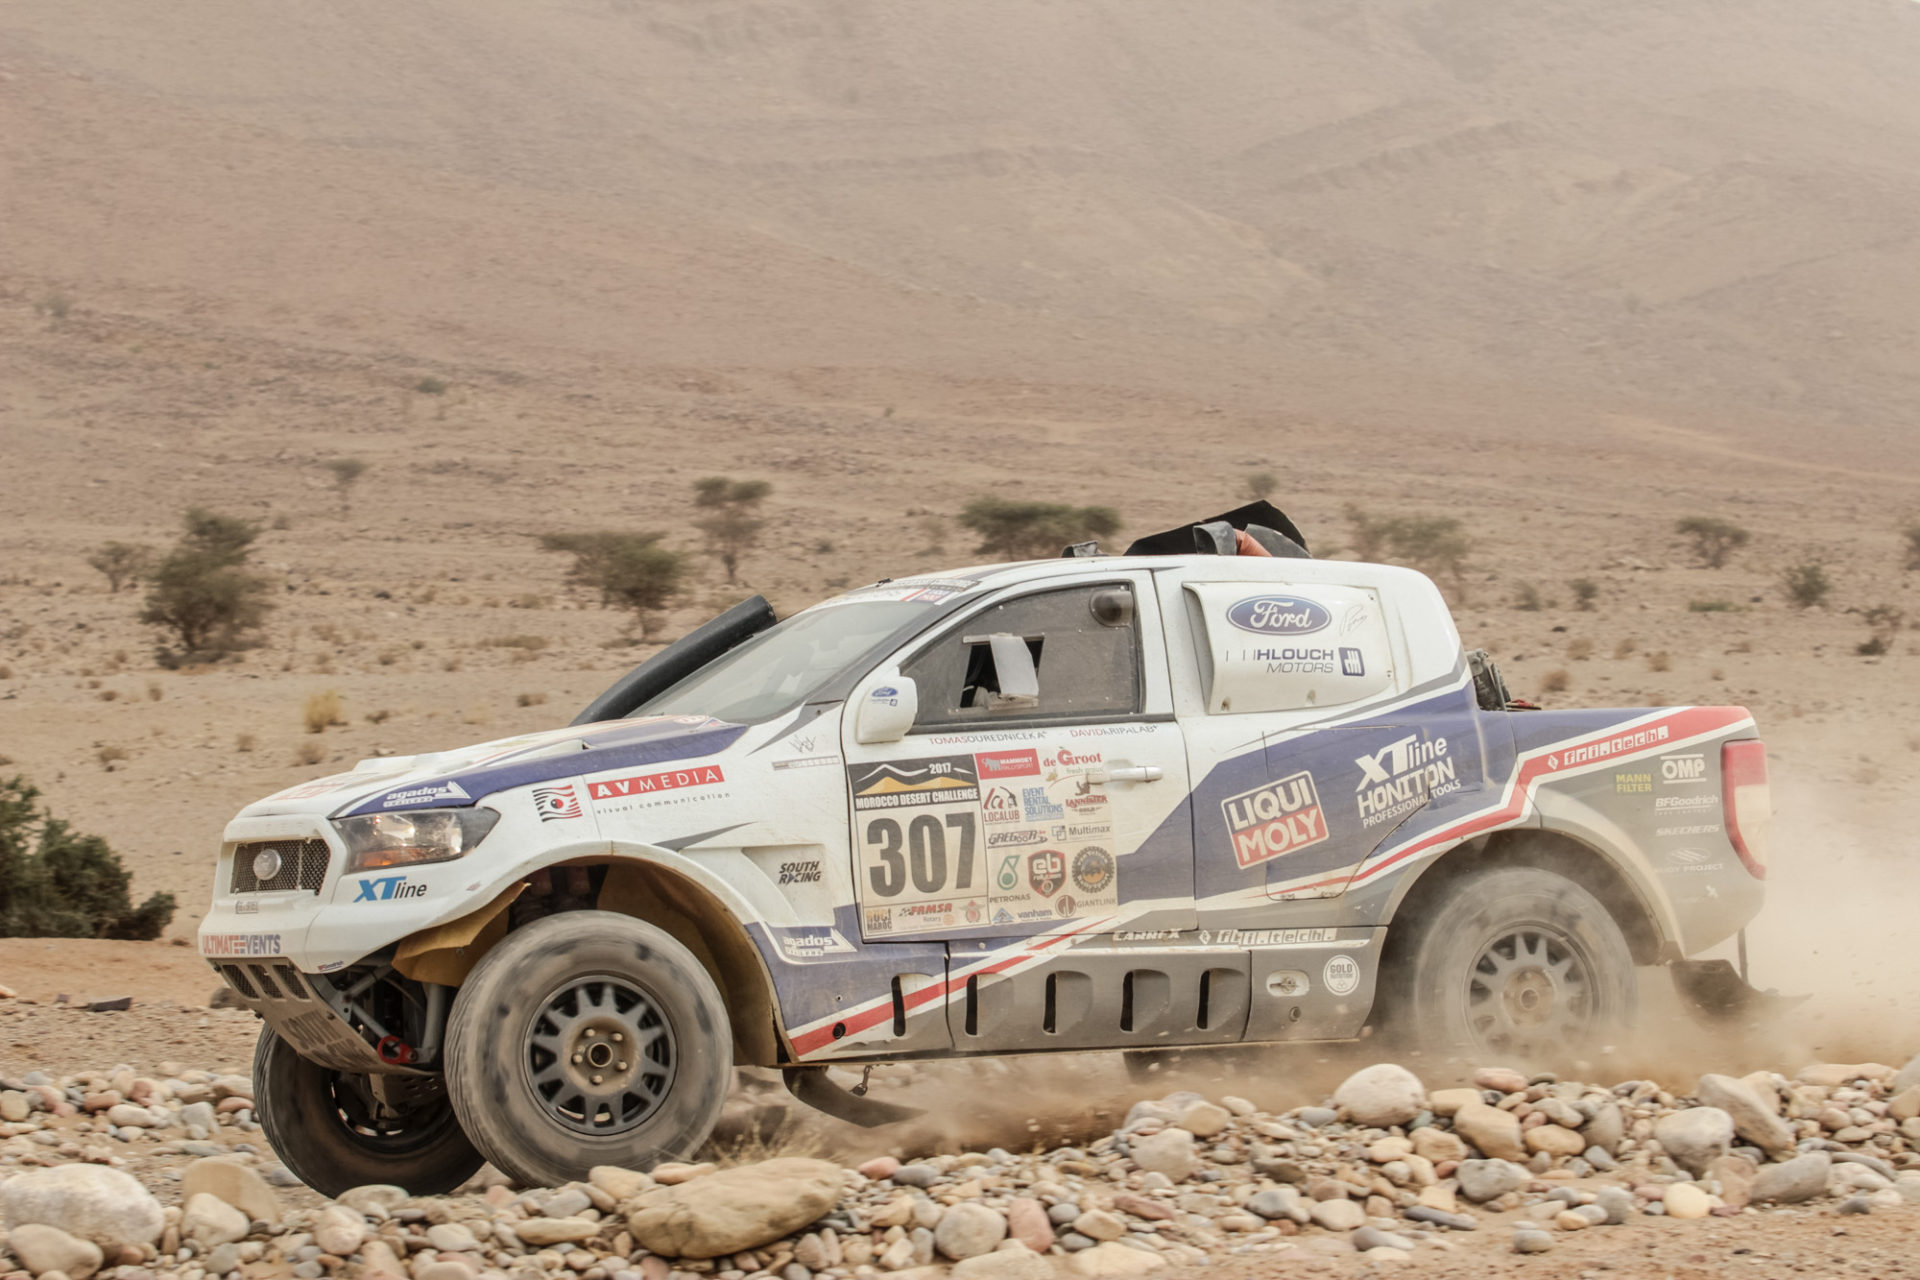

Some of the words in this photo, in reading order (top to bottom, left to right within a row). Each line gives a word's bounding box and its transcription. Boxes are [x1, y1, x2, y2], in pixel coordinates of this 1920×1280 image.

[1250, 600, 1312, 628] Ford
[1257, 648, 1334, 661] HLOUCH
[1266, 662, 1334, 674] MOTORS
[1043, 757, 1056, 768] de
[1057, 749, 1102, 766] Groot
[1354, 733, 1447, 792] XTline
[929, 762, 952, 774] 2017
[1662, 759, 1705, 780] OMP
[1616, 773, 1652, 783] MANN
[386, 786, 448, 800] agados
[1022, 786, 1044, 798] EVENT
[1357, 756, 1455, 819] HONITON
[1616, 783, 1652, 792] FILTER
[597, 805, 633, 814] visual
[639, 792, 730, 809] communication
[855, 795, 899, 809] MOROCCO
[900, 791, 931, 804] DESERT
[932, 788, 978, 803] CHALLENGE
[1023, 796, 1050, 807] RENTAL
[1228, 778, 1313, 830] LIQUI
[1363, 793, 1431, 829] PROFESSIONAL
[1431, 778, 1461, 799] TOOLS
[1655, 795, 1719, 807] BFGoodrich
[1024, 804, 1063, 815] SOLUTIONS
[984, 810, 1020, 822] LOCALUB
[1069, 825, 1110, 836] Multimax
[1237, 808, 1321, 863] MOLY
[1655, 824, 1721, 836] SKECHERS
[867, 812, 976, 897] 307
[779, 861, 820, 873] SOUTH
[1683, 863, 1724, 873] PROJECT
[353, 876, 427, 903] XTline
[989, 893, 1031, 903] PETRONAS
[1077, 898, 1117, 908] GIANTLINK
[1018, 909, 1053, 919] vanham
[1330, 964, 1353, 974] GOLD
